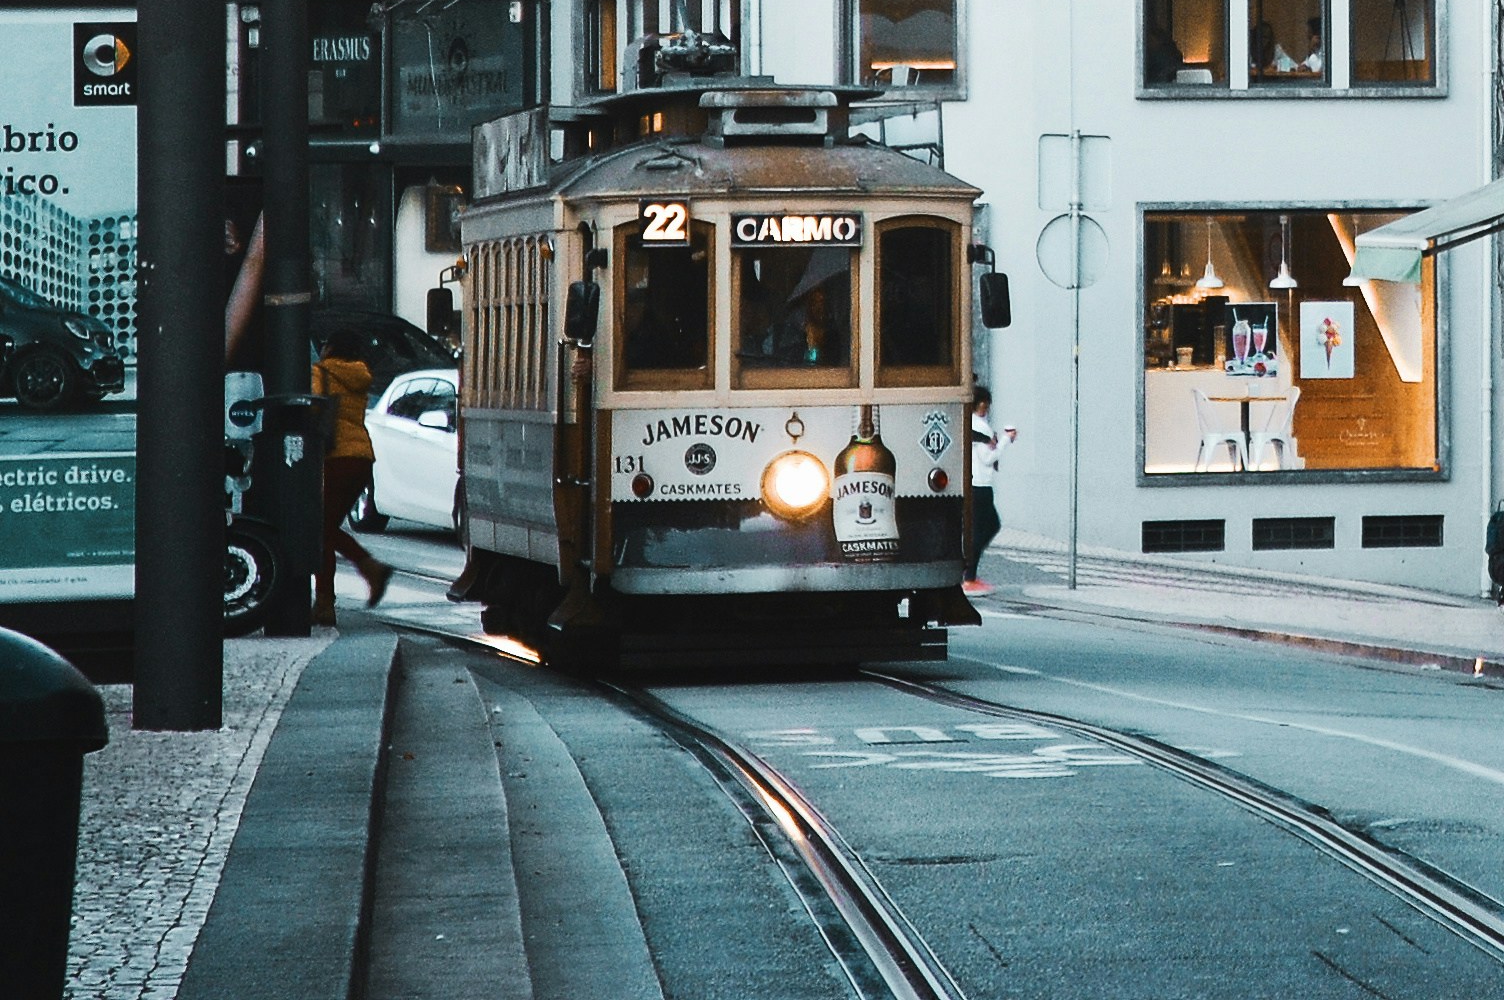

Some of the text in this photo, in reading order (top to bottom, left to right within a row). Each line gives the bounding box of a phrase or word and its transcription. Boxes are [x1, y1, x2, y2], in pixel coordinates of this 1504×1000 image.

[312, 36, 370, 62] ERASMUS
[83, 82, 131, 96] smart
[0, 123, 79, 153] brio
[0, 166, 69, 196] ico.
[642, 203, 687, 240] 22
[736, 215, 856, 242] CARMO
[642, 414, 760, 447] JAMESON
[0, 464, 132, 487] ctric drive.
[613, 455, 645, 474] 131
[660, 483, 741, 496] CASKMATES
[837, 480, 895, 501] JAMESON
[10, 491, 119, 513] elétricos.
